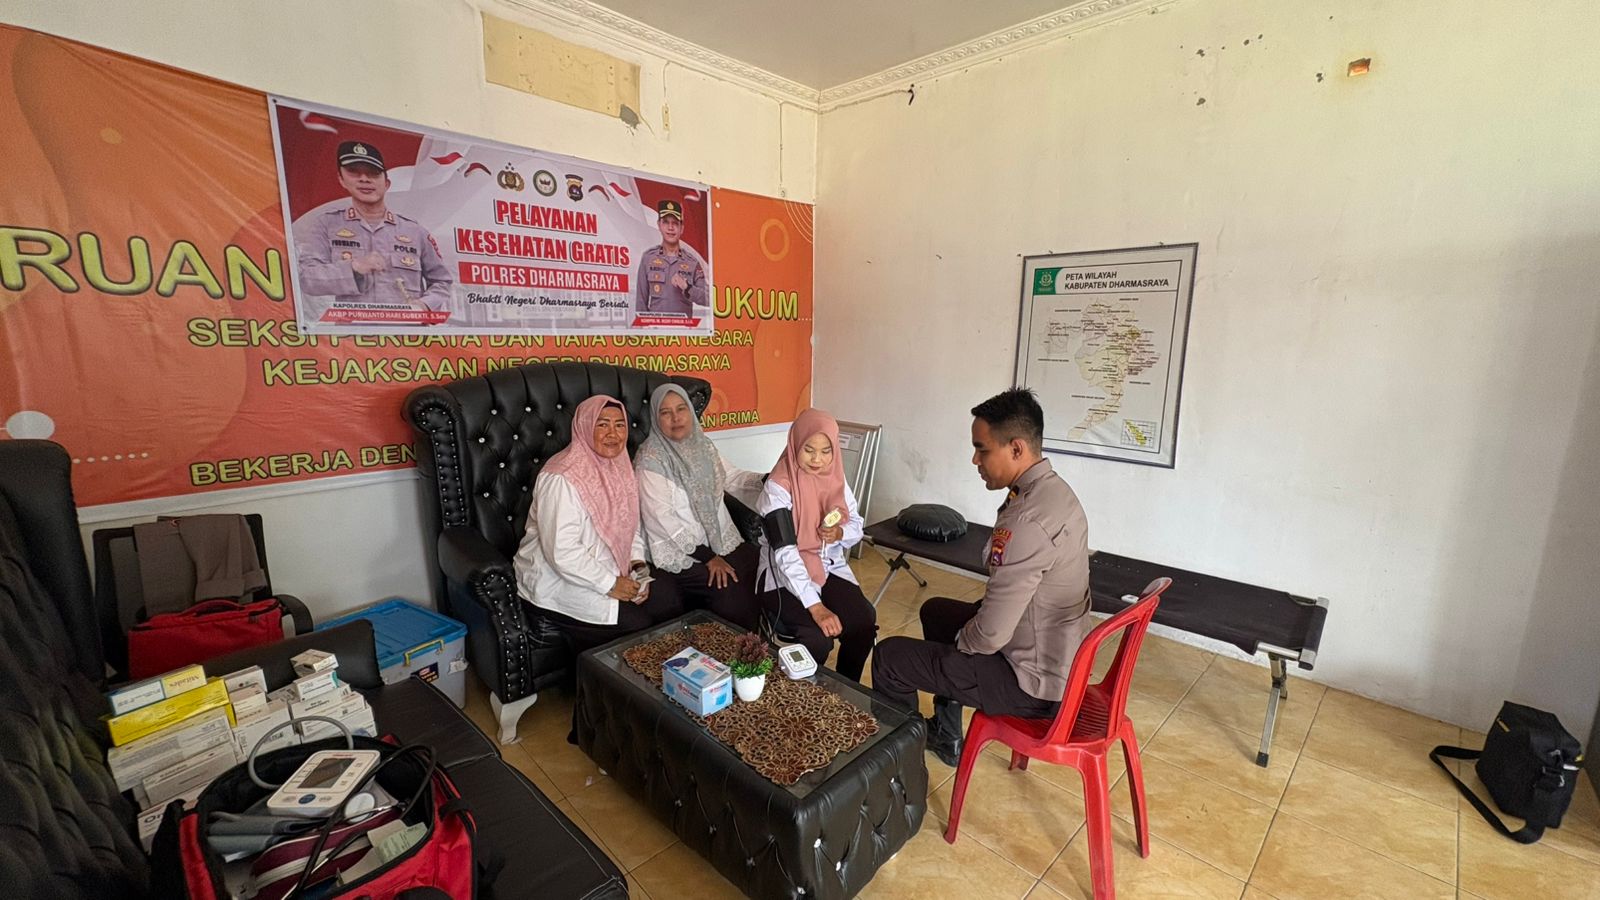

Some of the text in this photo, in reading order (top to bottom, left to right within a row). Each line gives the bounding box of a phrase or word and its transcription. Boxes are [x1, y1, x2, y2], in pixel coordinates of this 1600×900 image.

[494, 198, 598, 236] PELAYANAN
[394, 244, 417, 254] POLRI
[454, 227, 630, 268] KESEHATAN GRATIS
[0, 226, 799, 321] RUAN UKUM
[471, 264, 620, 291] POLRES DHARMASRAYA
[1064, 279, 1169, 290] KABUPATEN DHARMASRAYA
[1065, 271, 1117, 281] PETA WILAYAH
[467, 292, 629, 309] Bhakti Negeri Dharmasraya Bersatu
[348, 311, 385, 319] PURWANTO
[686, 330, 754, 347] NEGARA
[262, 357, 478, 385] KEJAKSAAN
[190, 449, 353, 486] BEKERJA
[720, 409, 760, 427] PRIMA
